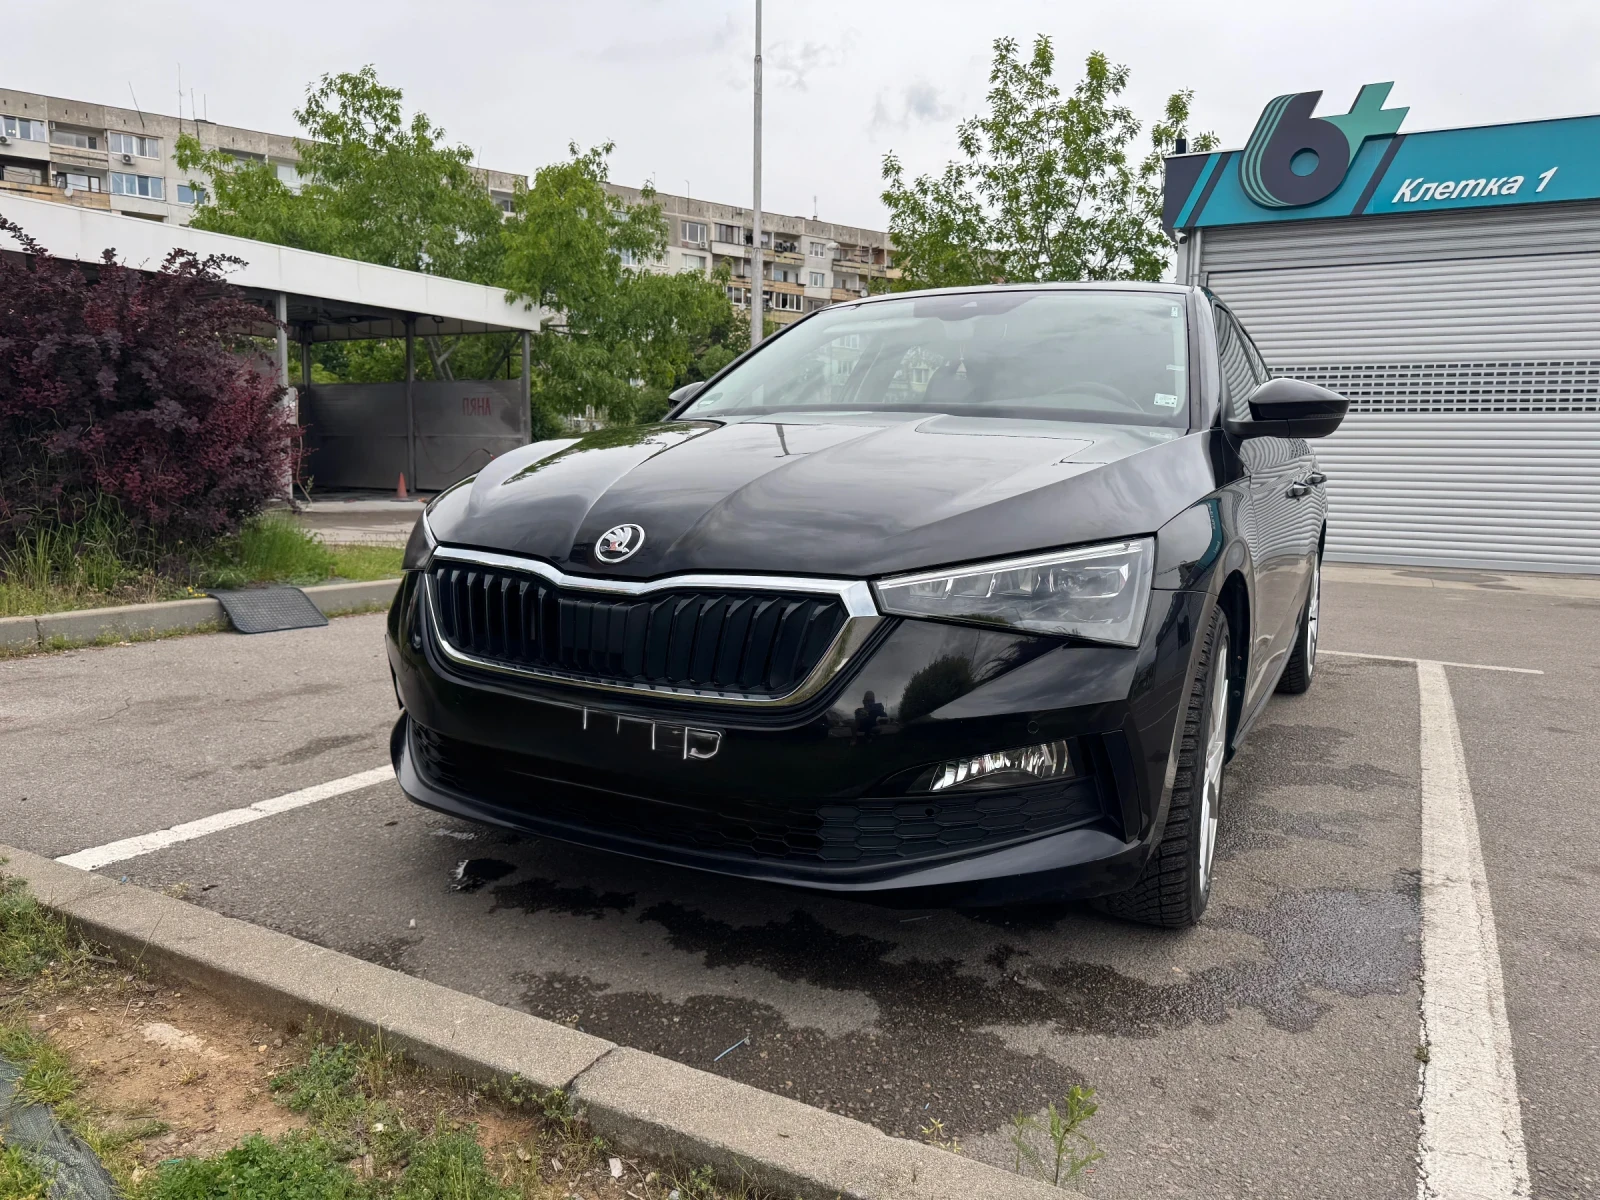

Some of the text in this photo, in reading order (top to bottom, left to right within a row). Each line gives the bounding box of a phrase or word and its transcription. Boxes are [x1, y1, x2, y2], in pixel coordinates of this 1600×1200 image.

[1391, 166, 1558, 204] Клетка 1
[462, 397, 492, 416] ПЯНА
